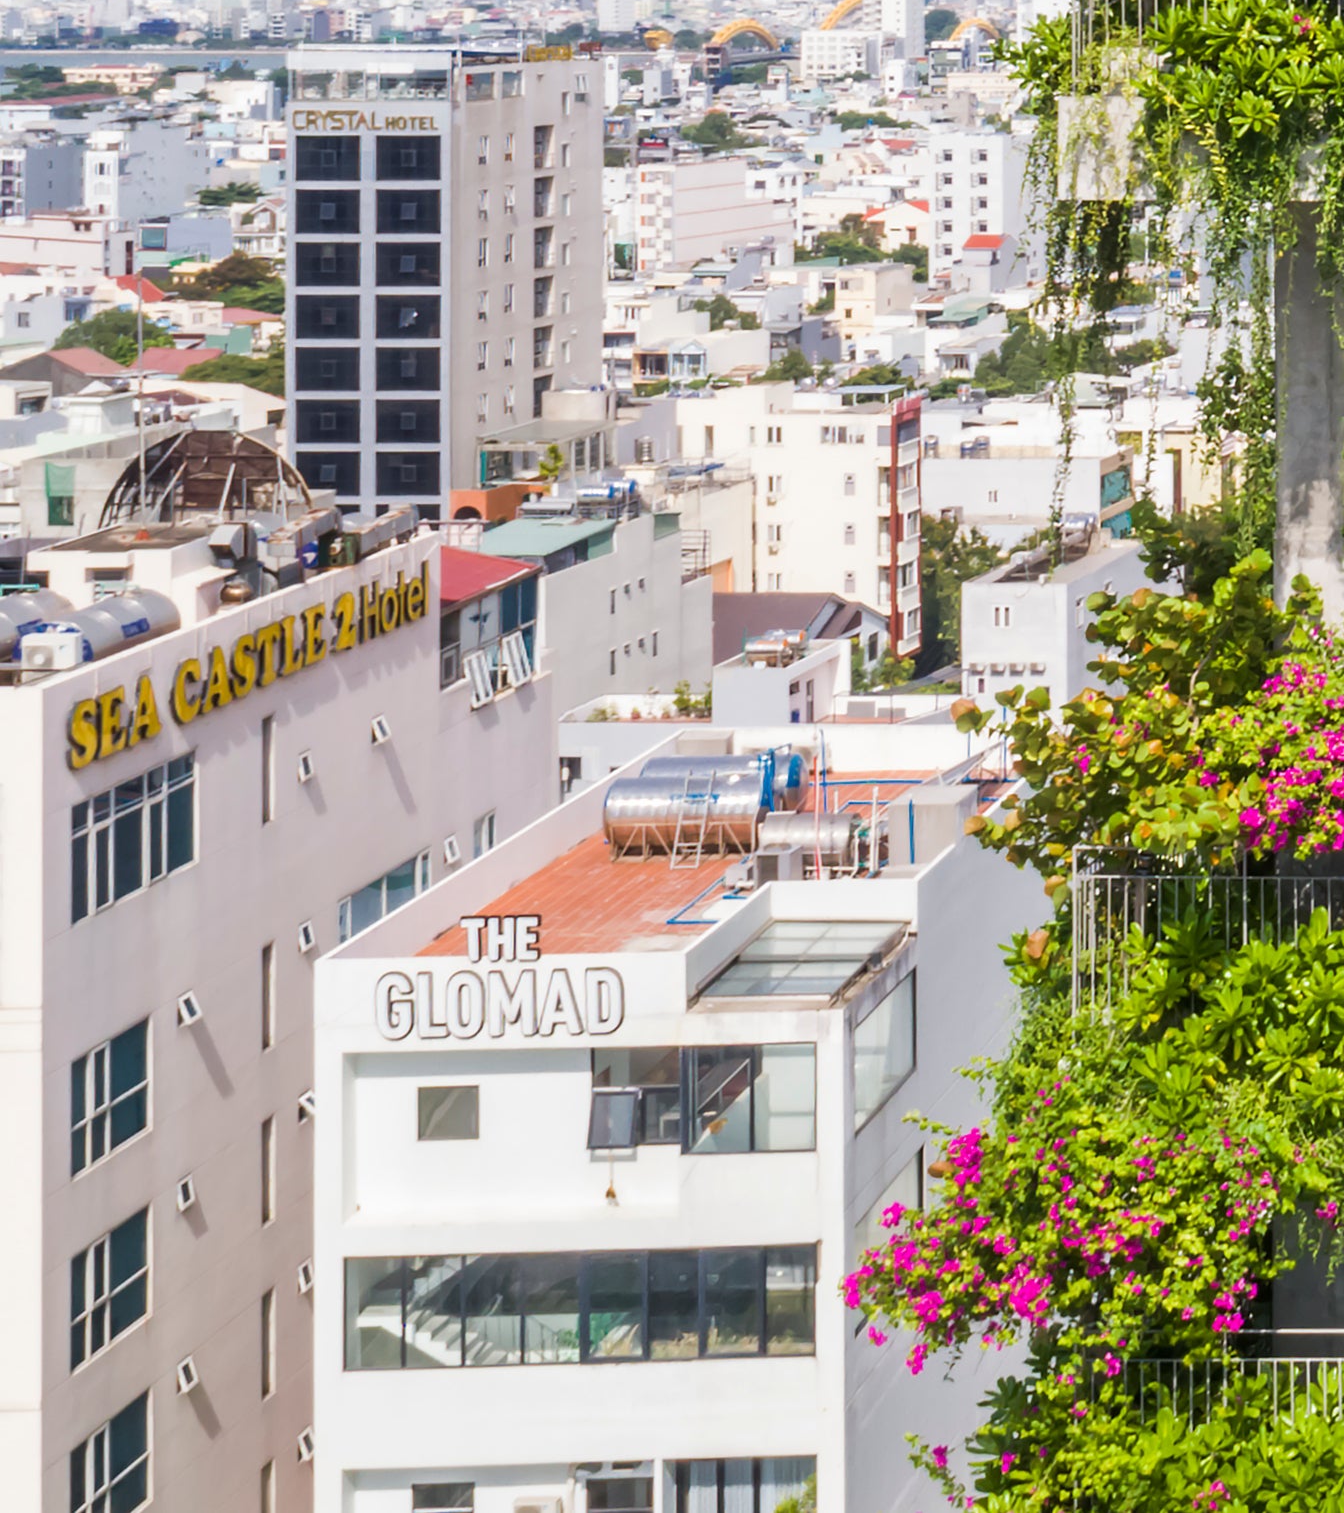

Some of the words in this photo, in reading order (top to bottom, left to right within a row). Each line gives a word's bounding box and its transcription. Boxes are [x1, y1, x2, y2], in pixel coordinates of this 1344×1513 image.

[292, 109, 382, 131] CRYSTAL
[385, 115, 439, 131] HOTEL
[67, 674, 162, 771] SEA
[169, 602, 327, 725] CASTLE
[331, 591, 357, 653] 2
[359, 559, 430, 645] Hotel
[460, 914, 542, 963] THE
[375, 966, 626, 1041] GLOMAD
